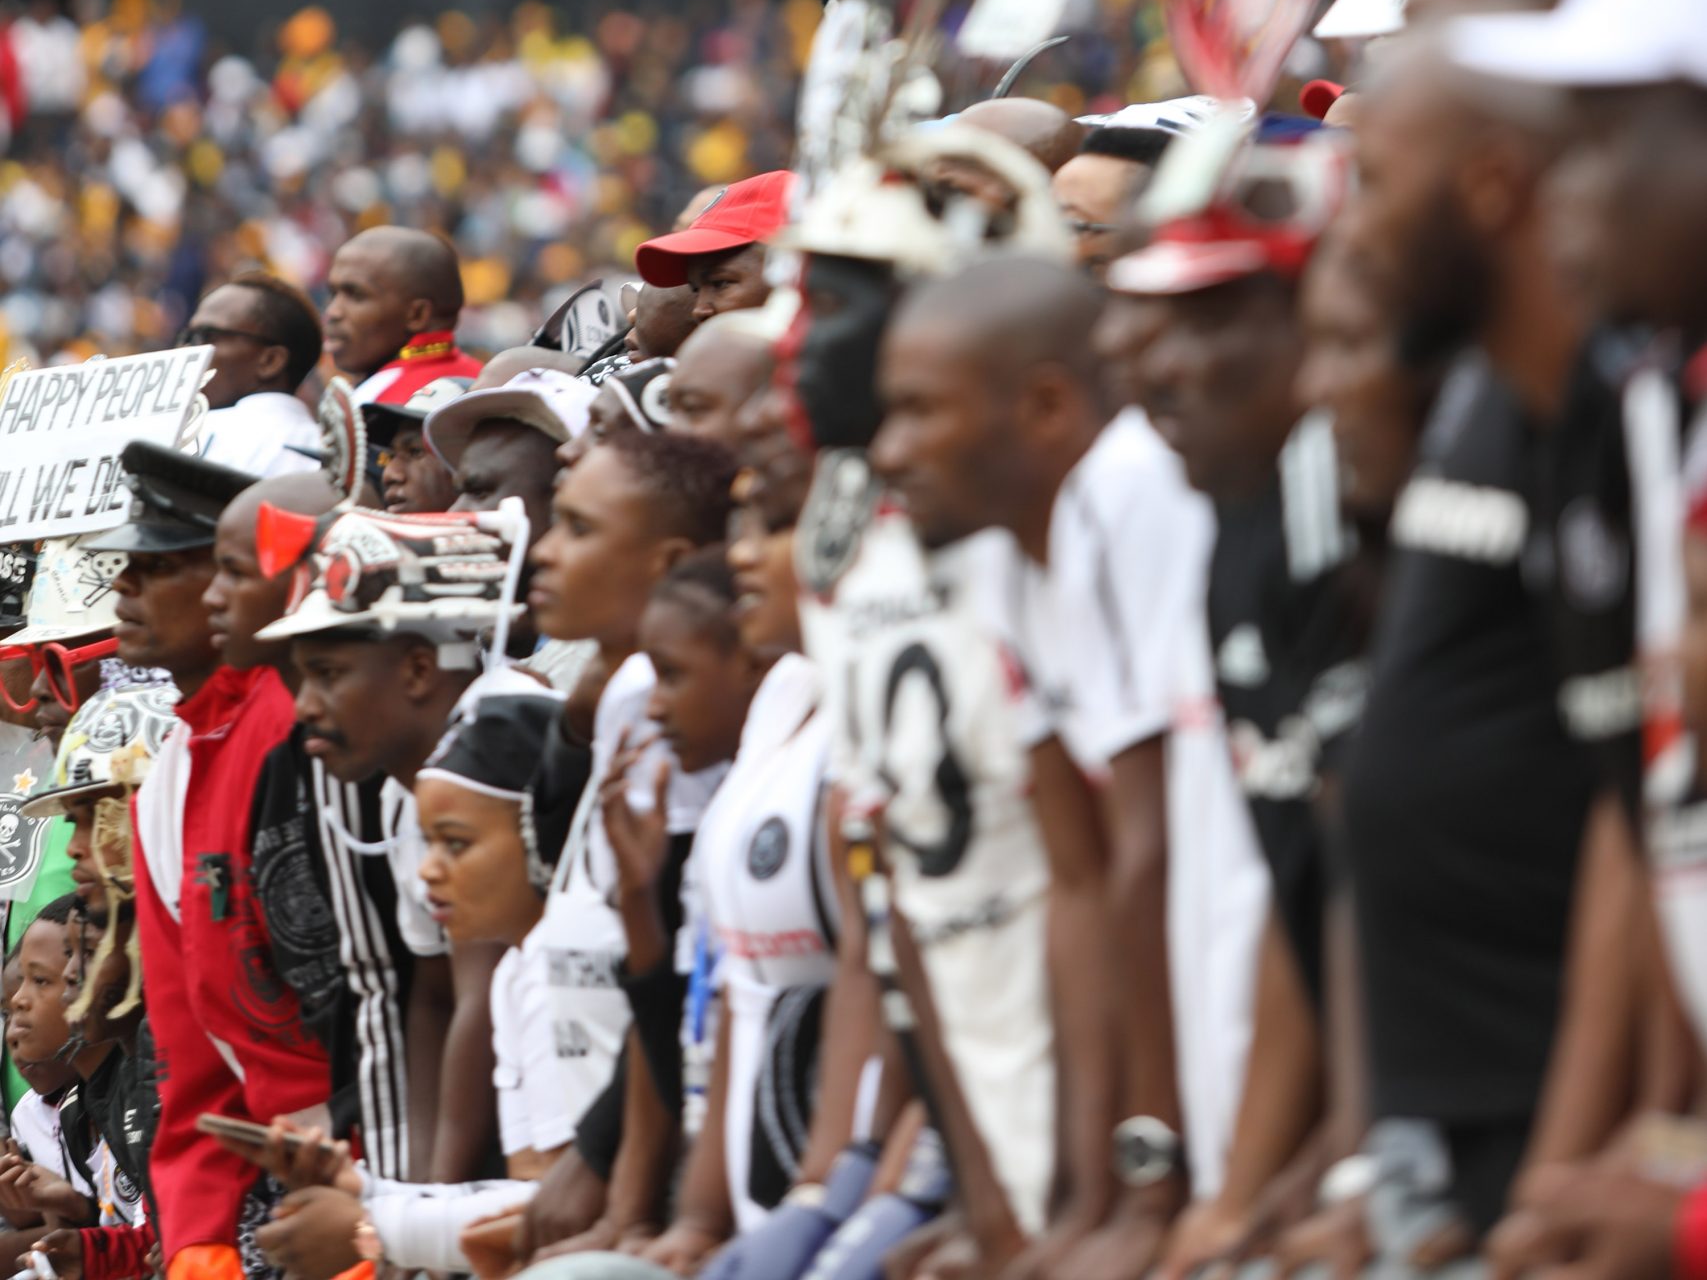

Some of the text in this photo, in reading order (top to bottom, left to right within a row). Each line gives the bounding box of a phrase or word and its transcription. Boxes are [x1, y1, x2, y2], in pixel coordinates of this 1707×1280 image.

[0, 353, 201, 435] HAPPY PEOPLE
[28, 458, 89, 523] WE
